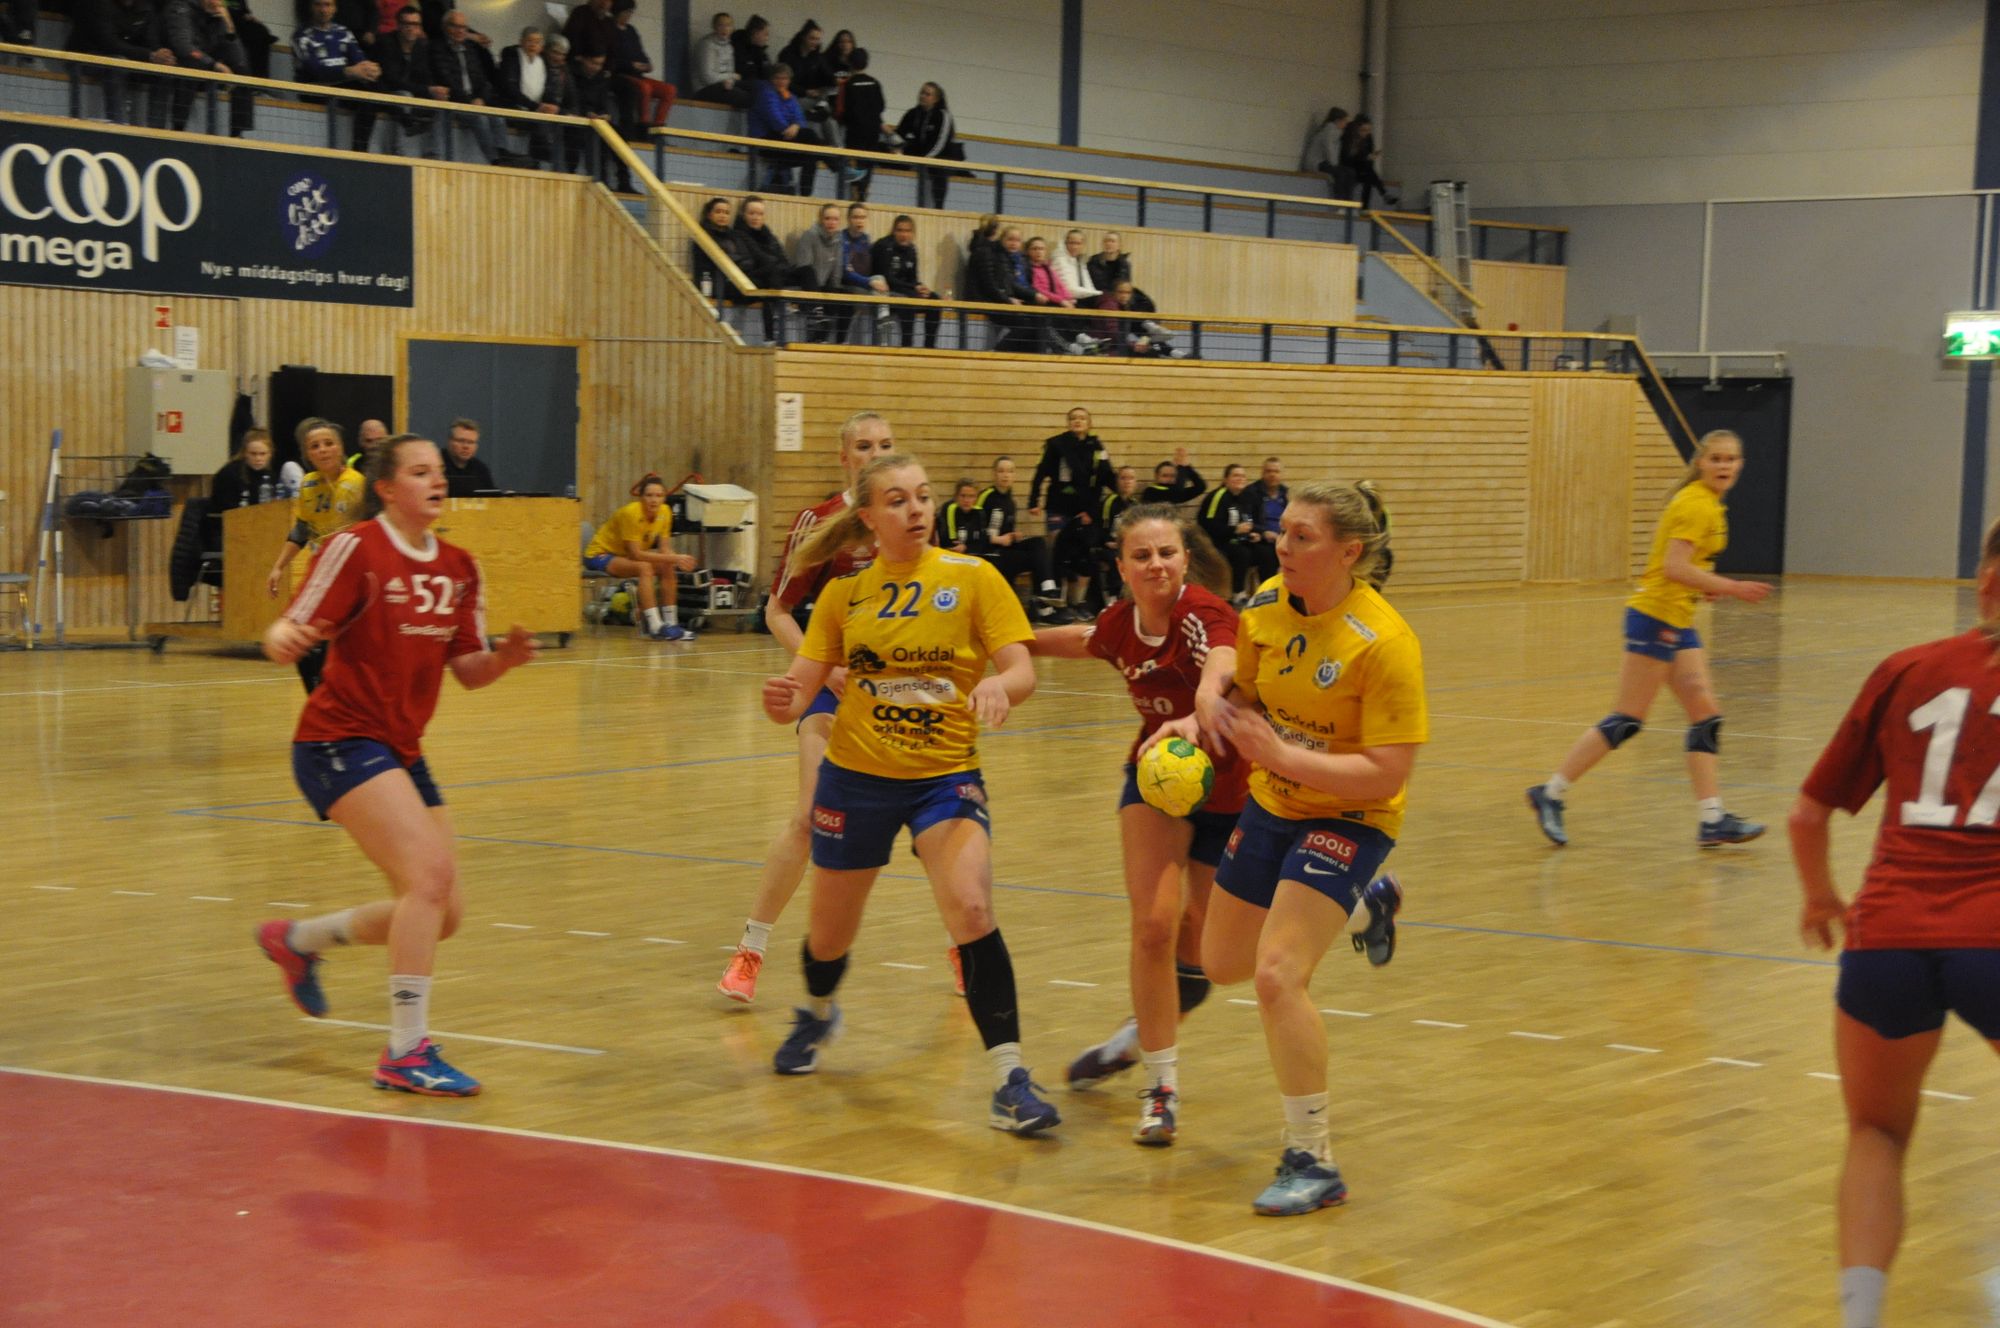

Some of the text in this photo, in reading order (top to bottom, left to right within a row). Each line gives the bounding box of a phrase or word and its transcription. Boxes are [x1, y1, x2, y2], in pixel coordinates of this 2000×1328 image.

[0, 142, 202, 262] coop
[0, 233, 133, 278] mega
[201, 260, 410, 292] Nye middagstips hver dag!
[411, 574, 455, 615] 52
[877, 581, 922, 619] 22
[892, 646, 955, 662] Orkdal
[878, 678, 951, 697] Gjensidige
[872, 704, 945, 728] coop
[1304, 833, 1352, 858] TOOLS
